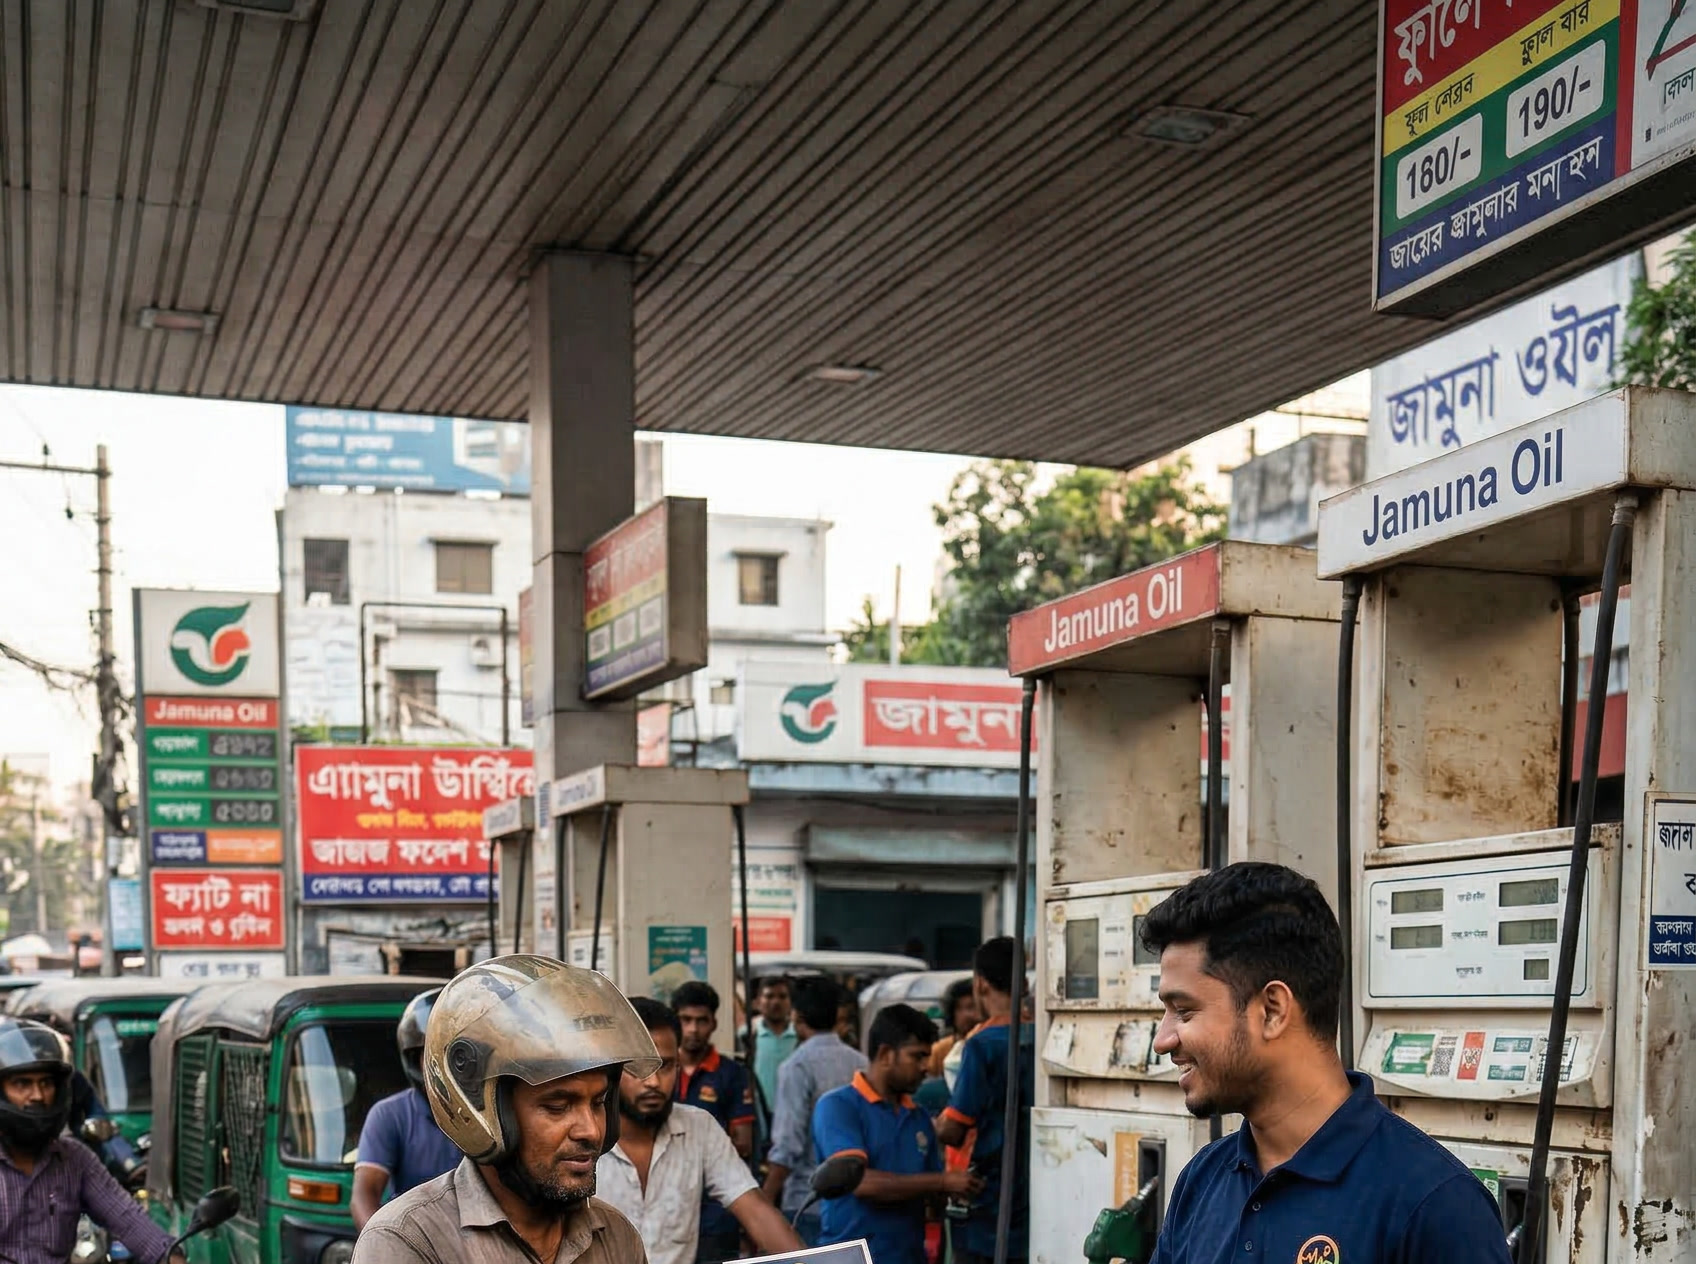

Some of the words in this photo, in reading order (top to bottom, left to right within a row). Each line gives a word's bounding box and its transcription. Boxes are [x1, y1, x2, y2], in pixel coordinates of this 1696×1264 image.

[1518, 65, 1591, 138] 190/-
[1386, 345, 1501, 448] জামুনা
[1363, 466, 1498, 546] Jamuna
[1511, 428, 1564, 496] Oil
[1044, 592, 1140, 653] Jamuna
[1147, 566, 1182, 620] Oil
[154, 700, 235, 721] Jamuna
[237, 702, 268, 723] Oil
[871, 696, 1021, 746] জামুন
